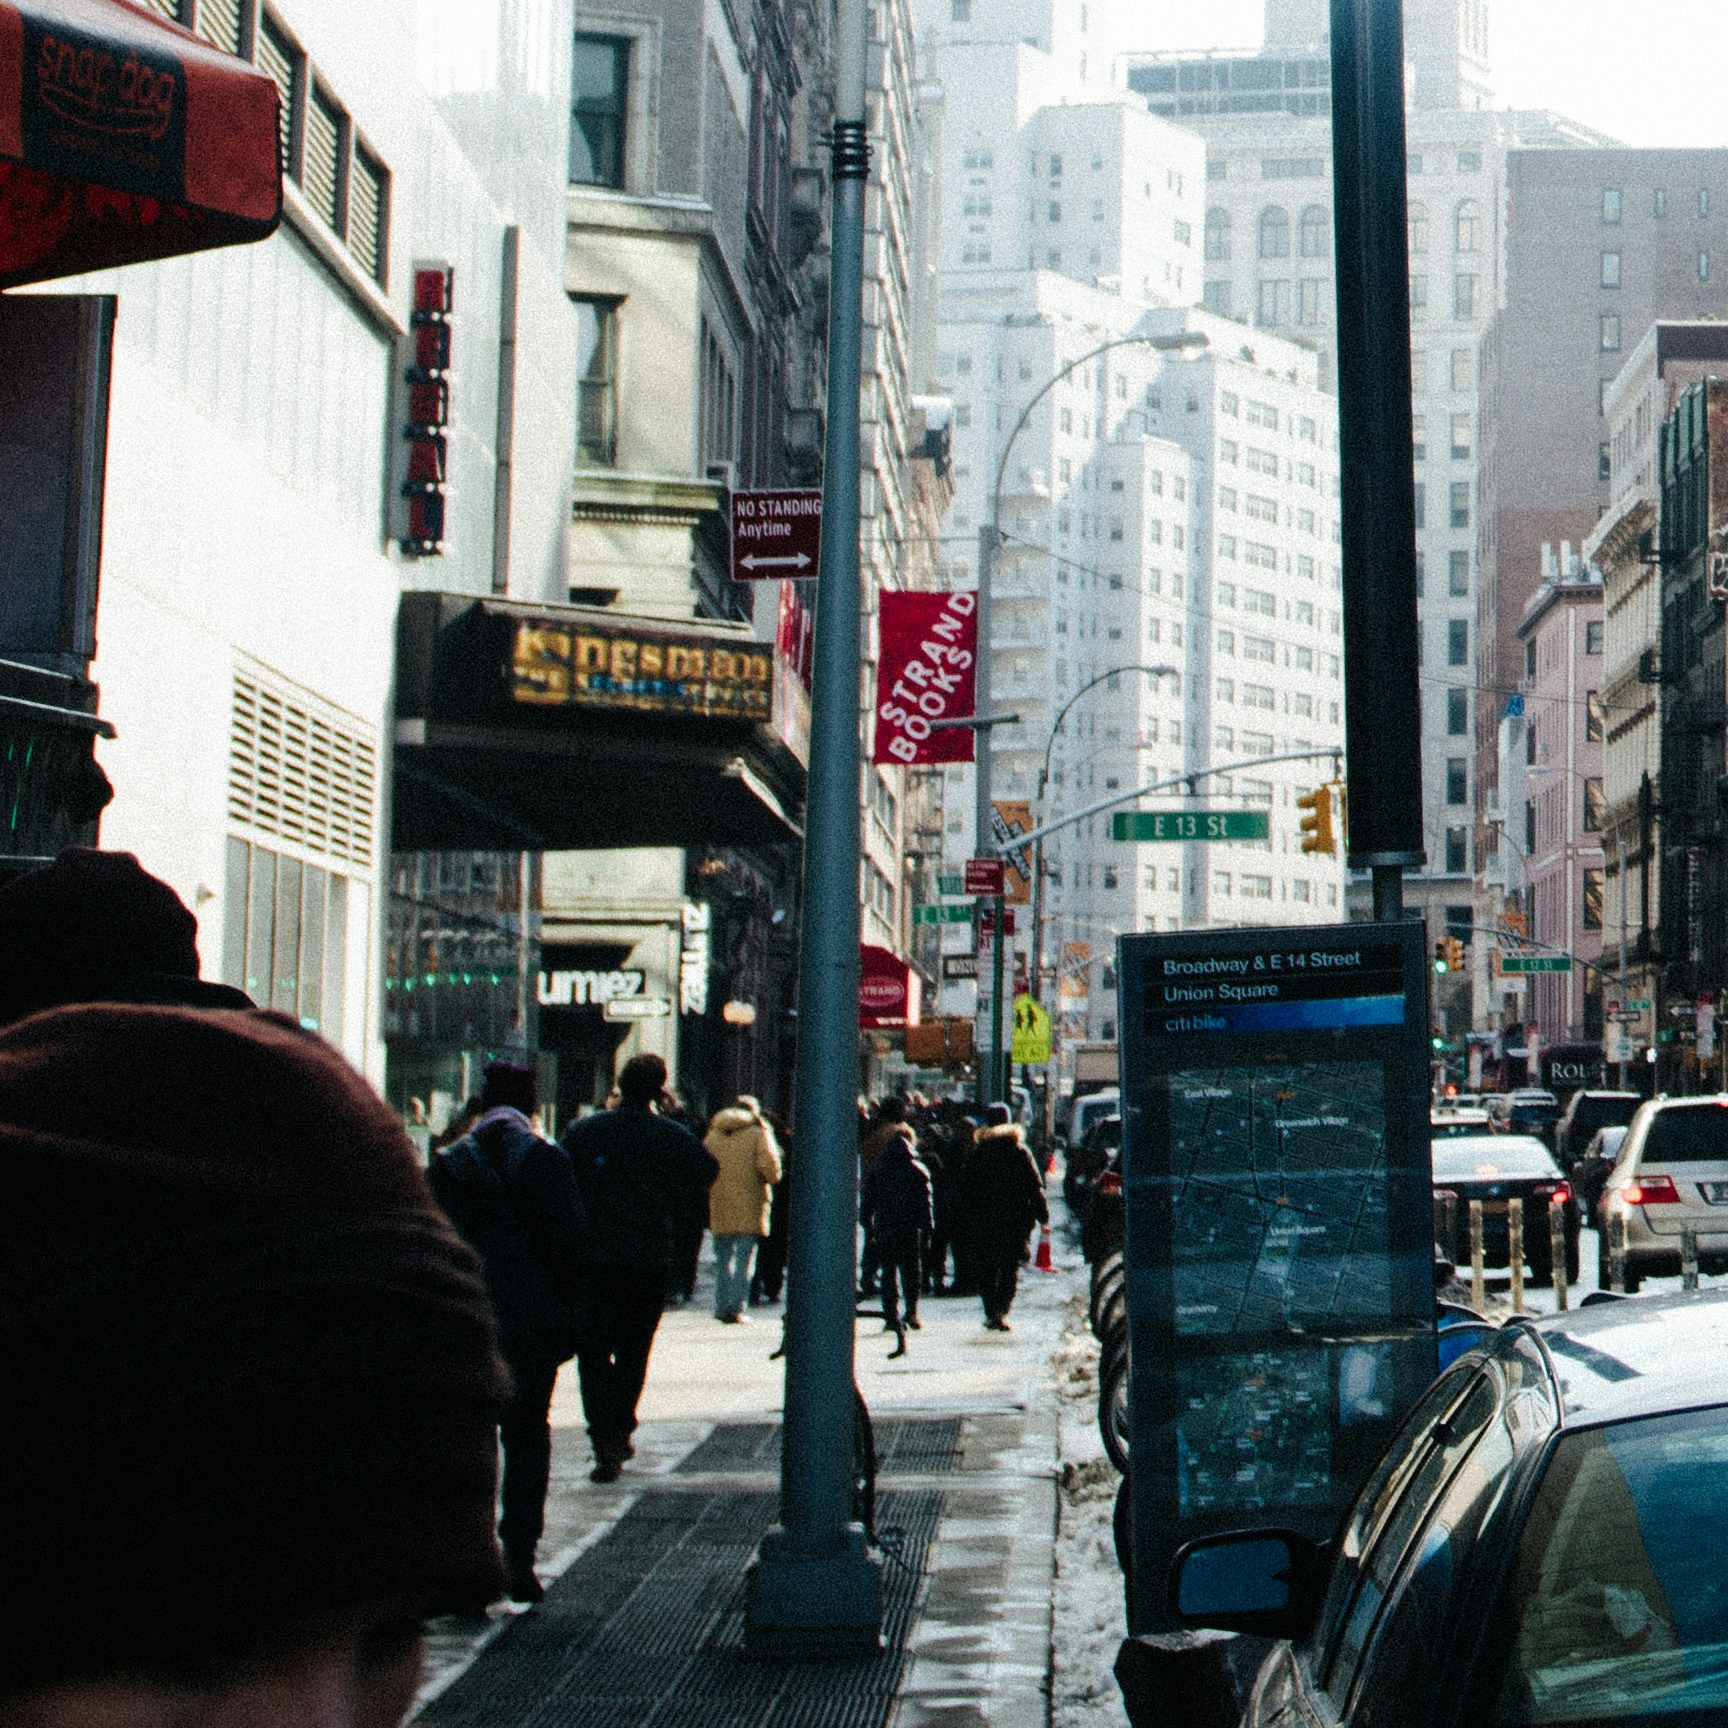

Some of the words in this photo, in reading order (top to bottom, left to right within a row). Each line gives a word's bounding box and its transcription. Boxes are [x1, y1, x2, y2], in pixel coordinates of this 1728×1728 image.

[737, 499, 755, 516] NO
[759, 498, 821, 516] STANDING
[739, 520, 791, 541] Anytime
[880, 592, 976, 727] STRAND
[888, 646, 973, 762] BOOKS
[1154, 816, 1165, 836] E
[1175, 816, 1196, 836] 13
[1207, 816, 1227, 836] St
[1164, 958, 1249, 976] Broadway
[1253, 955, 1266, 970] &
[1270, 954, 1282, 969] E
[1287, 954, 1306, 968] 14
[1311, 950, 1361, 967] Street
[537, 970, 643, 1005] umiez
[862, 984, 902, 998] TRAND
[1164, 984, 1214, 1002] Union
[1218, 982, 1279, 1000] Square
